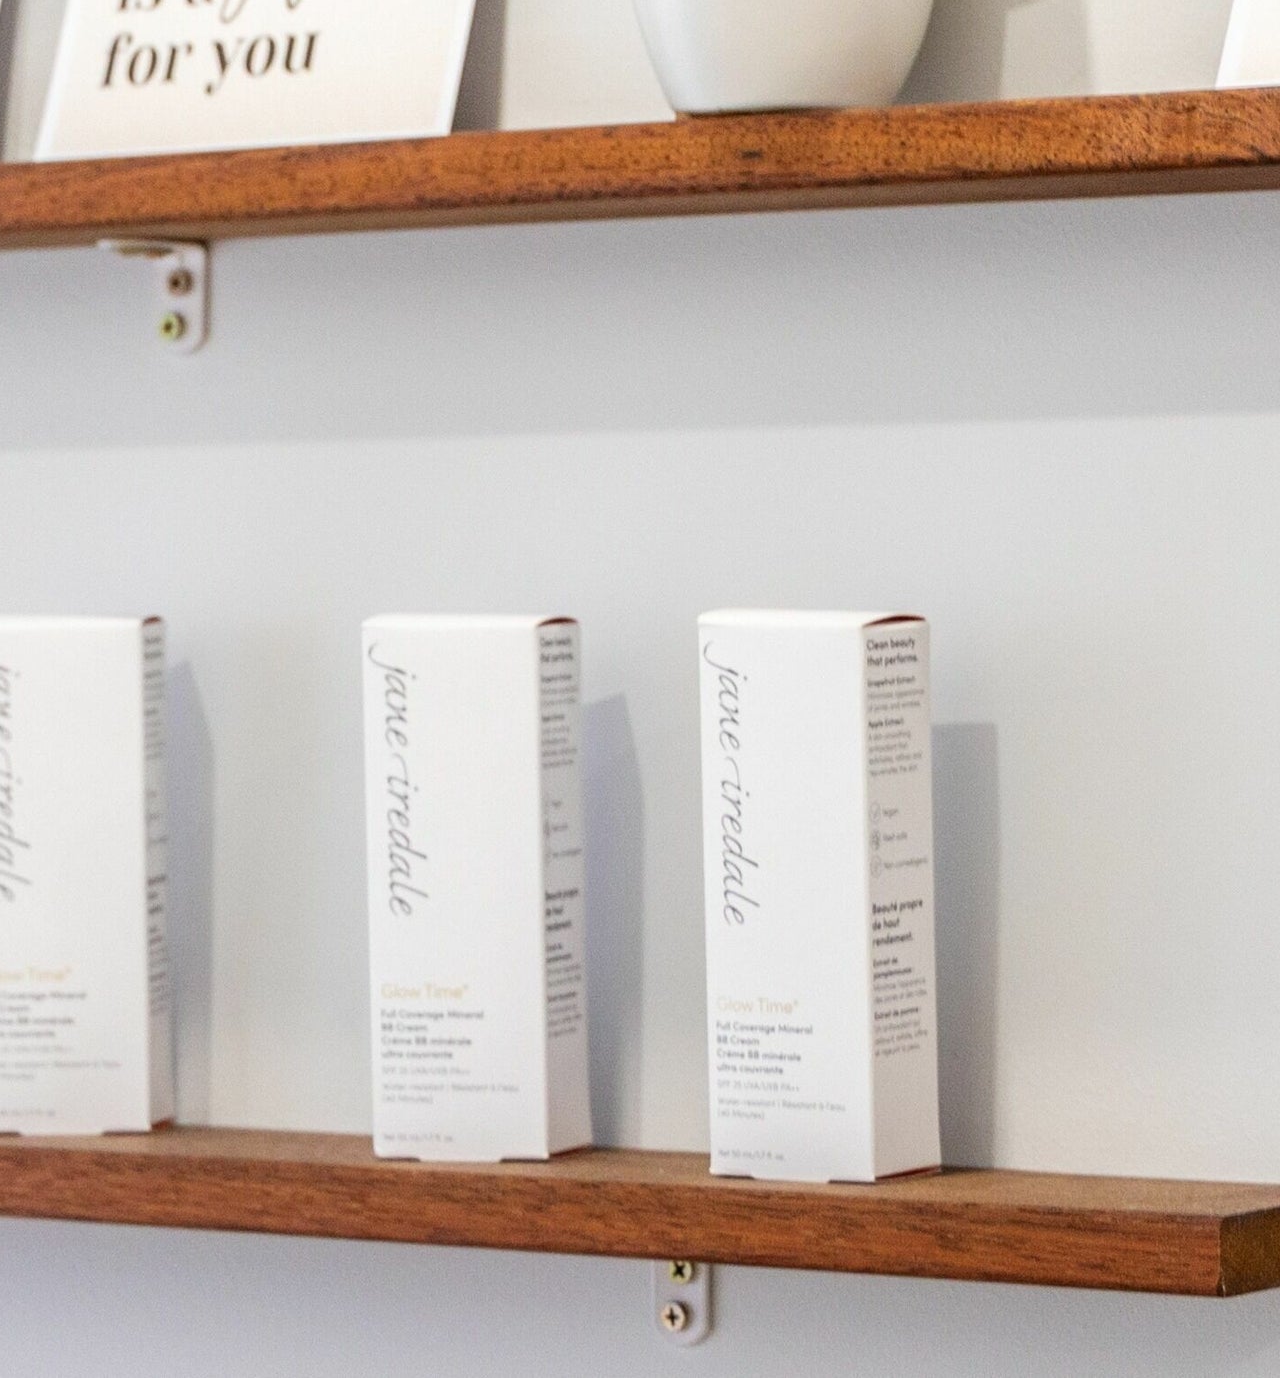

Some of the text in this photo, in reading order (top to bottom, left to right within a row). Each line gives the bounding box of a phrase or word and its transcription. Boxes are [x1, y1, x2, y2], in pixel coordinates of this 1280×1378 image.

[99, 30, 321, 96] for you
[368, 641, 428, 916] jane iredale
[704, 640, 761, 925] jane iredale
